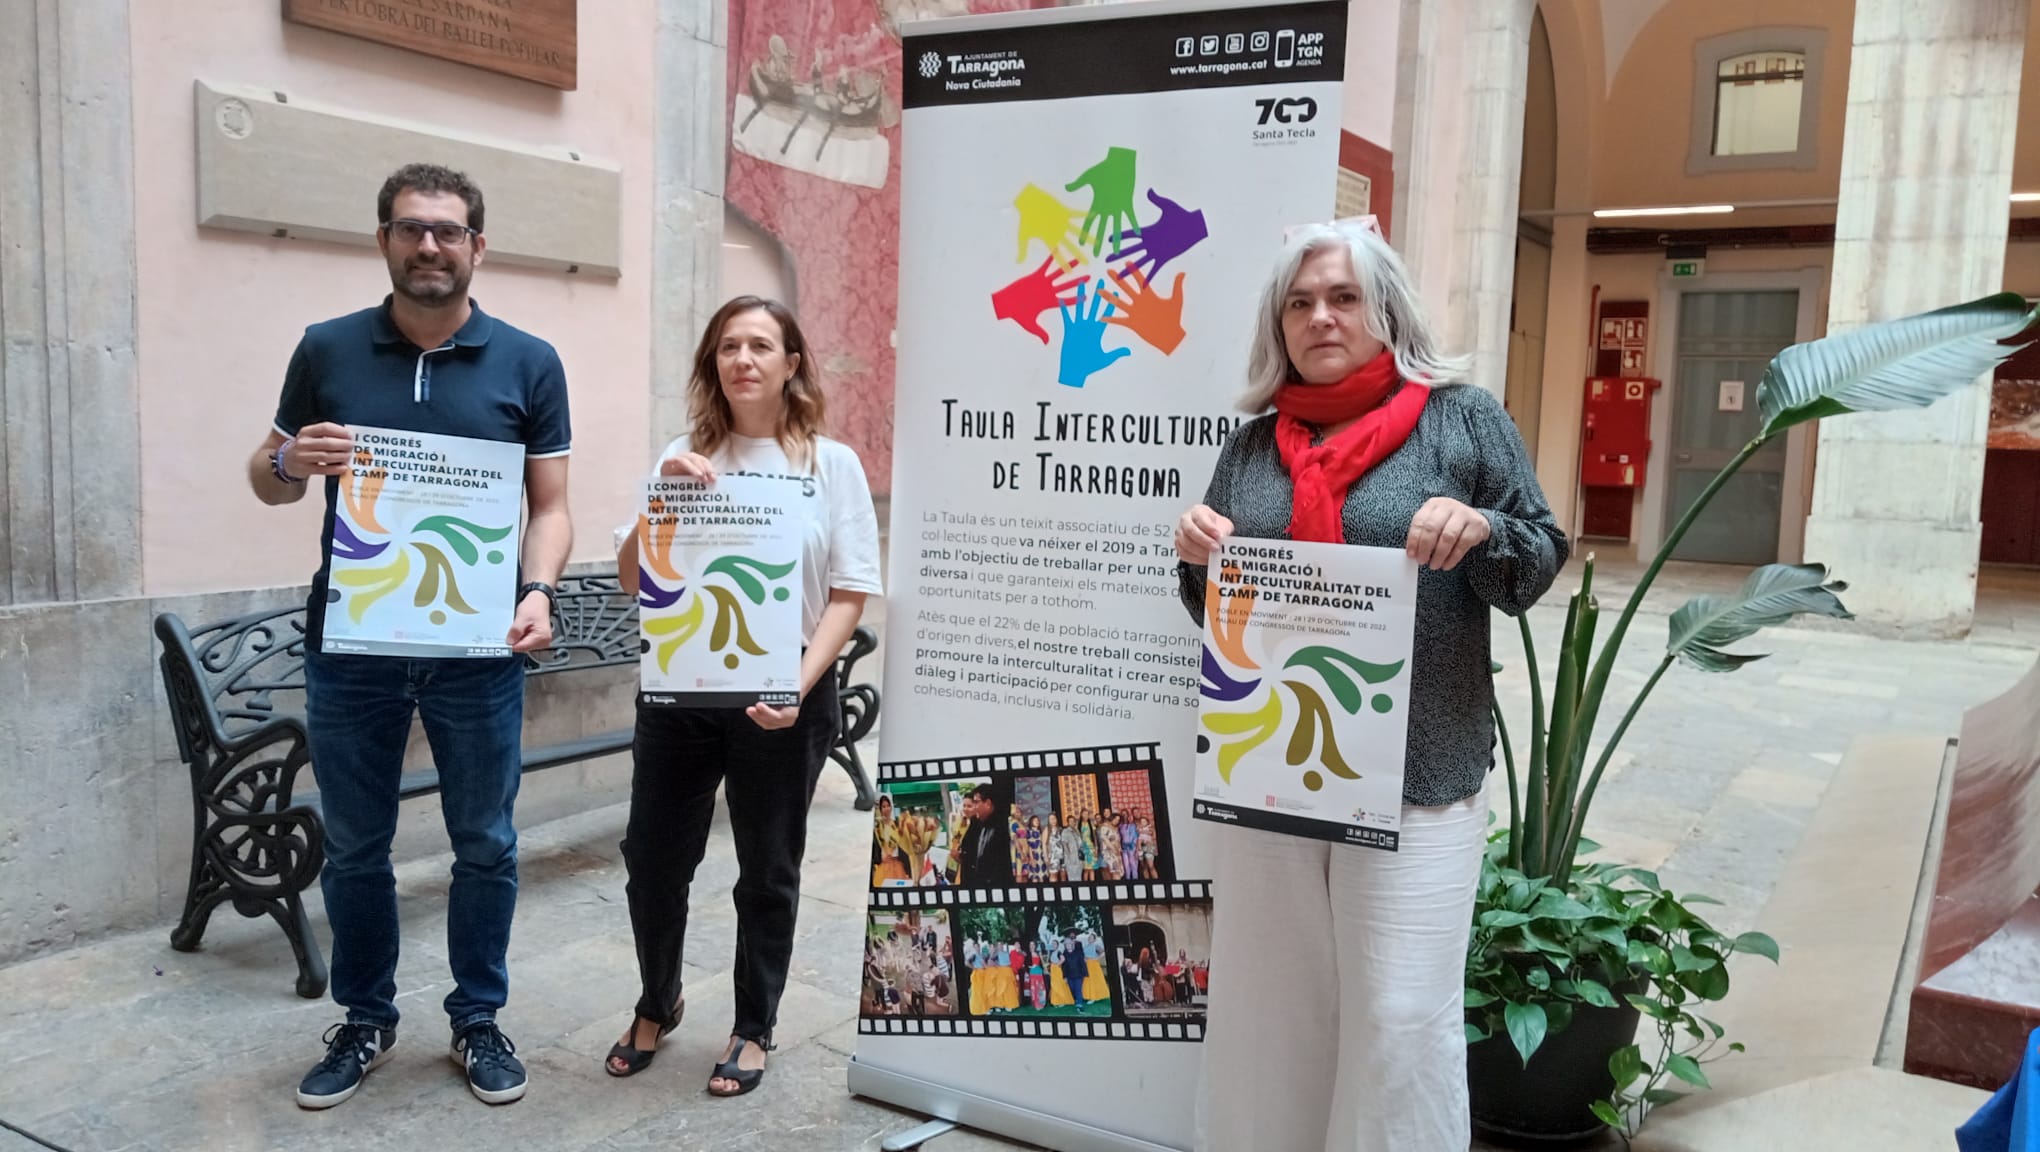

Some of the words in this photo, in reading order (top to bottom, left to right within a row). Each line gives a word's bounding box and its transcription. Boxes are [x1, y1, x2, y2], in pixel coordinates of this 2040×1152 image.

[1298, 32, 1324, 46] APP
[1297, 46, 1324, 59] TGN
[1169, 59, 1268, 75] www.tarragona.cat
[1296, 58, 1322, 67] AGENDA
[945, 80, 970, 91] Nova
[971, 76, 1021, 89] Ciutadania
[1252, 129, 1284, 140] Santa
[1286, 127, 1316, 138] Tecla
[355, 433, 359, 442] I
[362, 434, 422, 448] CONGRÉS
[353, 445, 370, 455] DE
[374, 447, 439, 461] MIGRACIÓ
[442, 454, 446, 462] I
[353, 457, 479, 478] INTERCULTURALITAT
[481, 470, 503, 480] DEL
[352, 469, 389, 480] CAMP
[393, 473, 408, 482] DE
[412, 475, 489, 489] TARRAGONA
[648, 483, 651, 491] I
[654, 481, 707, 491] CONGRÉS
[648, 494, 663, 503] DE
[665, 492, 724, 503] MIGRACIÓ
[648, 505, 760, 515] INTERCULTURALITAT
[764, 507, 784, 515] DEL
[648, 517, 680, 526] CAMP
[683, 517, 697, 525] DE
[700, 517, 772, 526] TARRAGONA
[922, 510, 938, 523] La
[940, 512, 976, 526] Taula
[980, 513, 996, 526] és
[1000, 516, 1016, 528] un
[1020, 516, 1053, 530] teixit
[1057, 520, 1127, 535] associatiu
[1132, 522, 1150, 536] de
[1154, 524, 1170, 537] 52
[990, 534, 1017, 550] que
[1019, 536, 1034, 548] va
[1038, 536, 1080, 550] néixer
[1086, 538, 1098, 552] el
[1102, 540, 1134, 554] 2019
[1140, 545, 1148, 556] a
[1152, 544, 1179, 558] Tar
[1221, 545, 1225, 554] I
[1228, 545, 1294, 560] CONGRÉS
[920, 548, 951, 561] amb
[954, 548, 1018, 566] l'objectiu
[1022, 554, 1039, 567] de
[1043, 556, 1102, 572] treballar
[1108, 562, 1132, 576] per
[1137, 564, 1165, 578] una
[1221, 558, 1239, 569] DE
[1242, 561, 1313, 576] MIGRACIÓ
[1317, 567, 1322, 577] I
[920, 565, 968, 580] diversa
[971, 567, 974, 580] i
[978, 571, 1003, 586] que
[1008, 572, 1074, 590] garanteixi
[1078, 578, 1097, 592] els
[1101, 582, 1167, 598] mateixos
[1219, 573, 1361, 595] INTERCULTURALITAT
[1364, 586, 1392, 598] DEL
[919, 584, 1000, 602] oportunitats
[1005, 592, 1027, 605] per
[1031, 595, 1038, 606] a
[1042, 594, 1096, 611] tothom.
[1218, 587, 1259, 599] CAMP
[1263, 592, 1281, 601] DE
[1285, 593, 1375, 612] TARRAGONA
[1250, 611, 1287, 621] MOVIMENT
[918, 610, 946, 624] Atès
[949, 614, 975, 630] que
[979, 616, 990, 627] el
[994, 616, 1020, 630] 22%
[1024, 619, 1040, 632] de
[1044, 620, 1055, 634] la
[1059, 622, 1120, 640] població
[1124, 630, 1200, 649] tarragonin
[1249, 620, 1295, 631] CONGRESSOS
[1308, 626, 1351, 637] TARRAGONA
[916, 628, 971, 644] d'origen
[975, 632, 1017, 650] divers,
[1018, 637, 1030, 650] el
[1034, 640, 1078, 655] nostre
[1082, 644, 1130, 660] treball
[1134, 650, 1200, 668] consistei
[916, 647, 984, 664] promoure
[988, 651, 999, 664] la
[1003, 655, 1113, 679] interculturalitat
[1118, 666, 1122, 680] i
[1126, 670, 1165, 684] crear
[1169, 675, 1200, 690] espa
[915, 664, 956, 682] diàleg
[960, 667, 964, 680] i
[968, 670, 1048, 690] participació
[1050, 682, 1072, 694] per
[1076, 684, 1148, 702] configurar
[1152, 692, 1180, 706] una
[1184, 697, 1200, 708] so
[914, 682, 1000, 705] cohesionada,
[1004, 692, 1060, 712] inclusiva
[1072, 701, 1134, 720] solidària.
